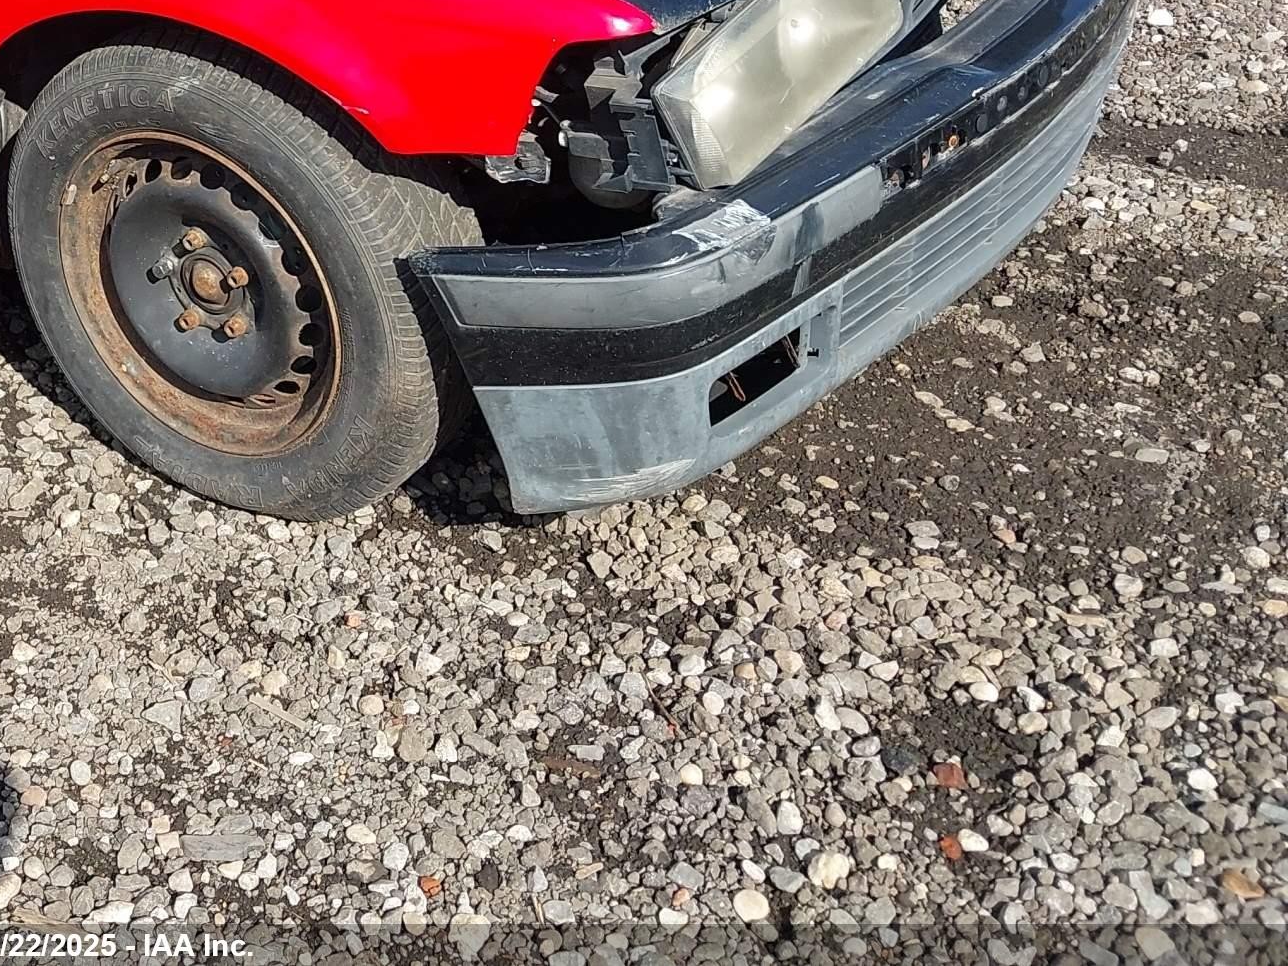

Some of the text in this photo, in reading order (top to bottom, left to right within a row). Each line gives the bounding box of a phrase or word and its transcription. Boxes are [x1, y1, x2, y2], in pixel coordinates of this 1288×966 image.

[35, 84, 176, 159] KENETICA
[133, 435, 264, 509] RADIAL
[283, 414, 377, 503] KENDA
